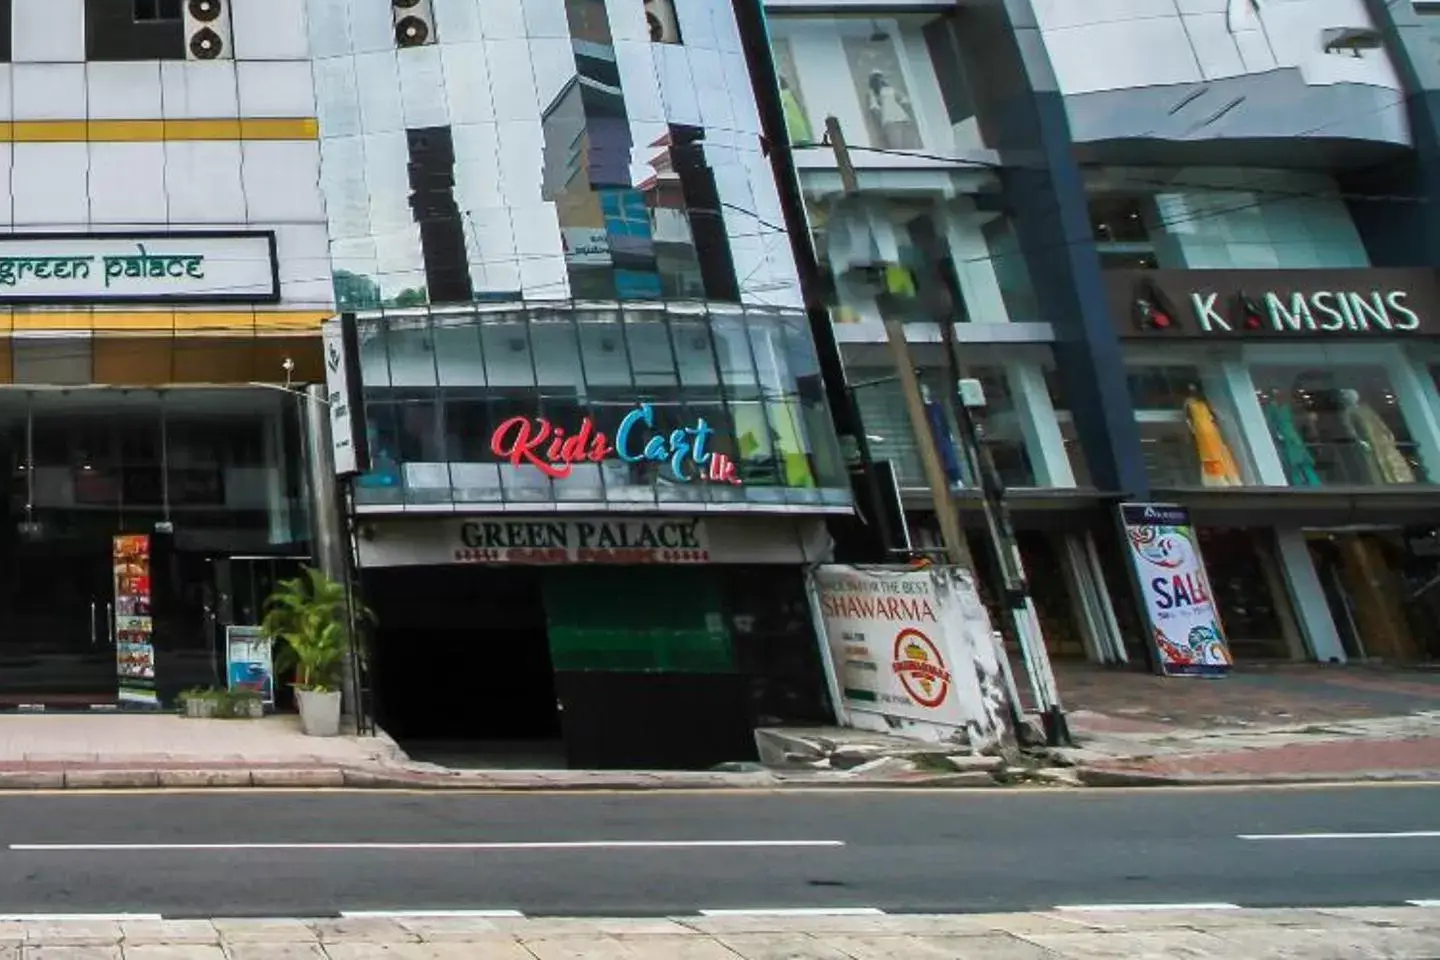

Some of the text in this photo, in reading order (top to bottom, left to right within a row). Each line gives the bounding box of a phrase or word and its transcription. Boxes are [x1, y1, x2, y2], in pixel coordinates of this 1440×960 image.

[102, 243, 205, 287] palace
[491, 416, 613, 479] Kids
[616, 403, 715, 481] Cart
[460, 521, 700, 548] GREEN PALACE
[902, 581, 929, 594] BEST
[822, 595, 938, 623] SHAWARMA
